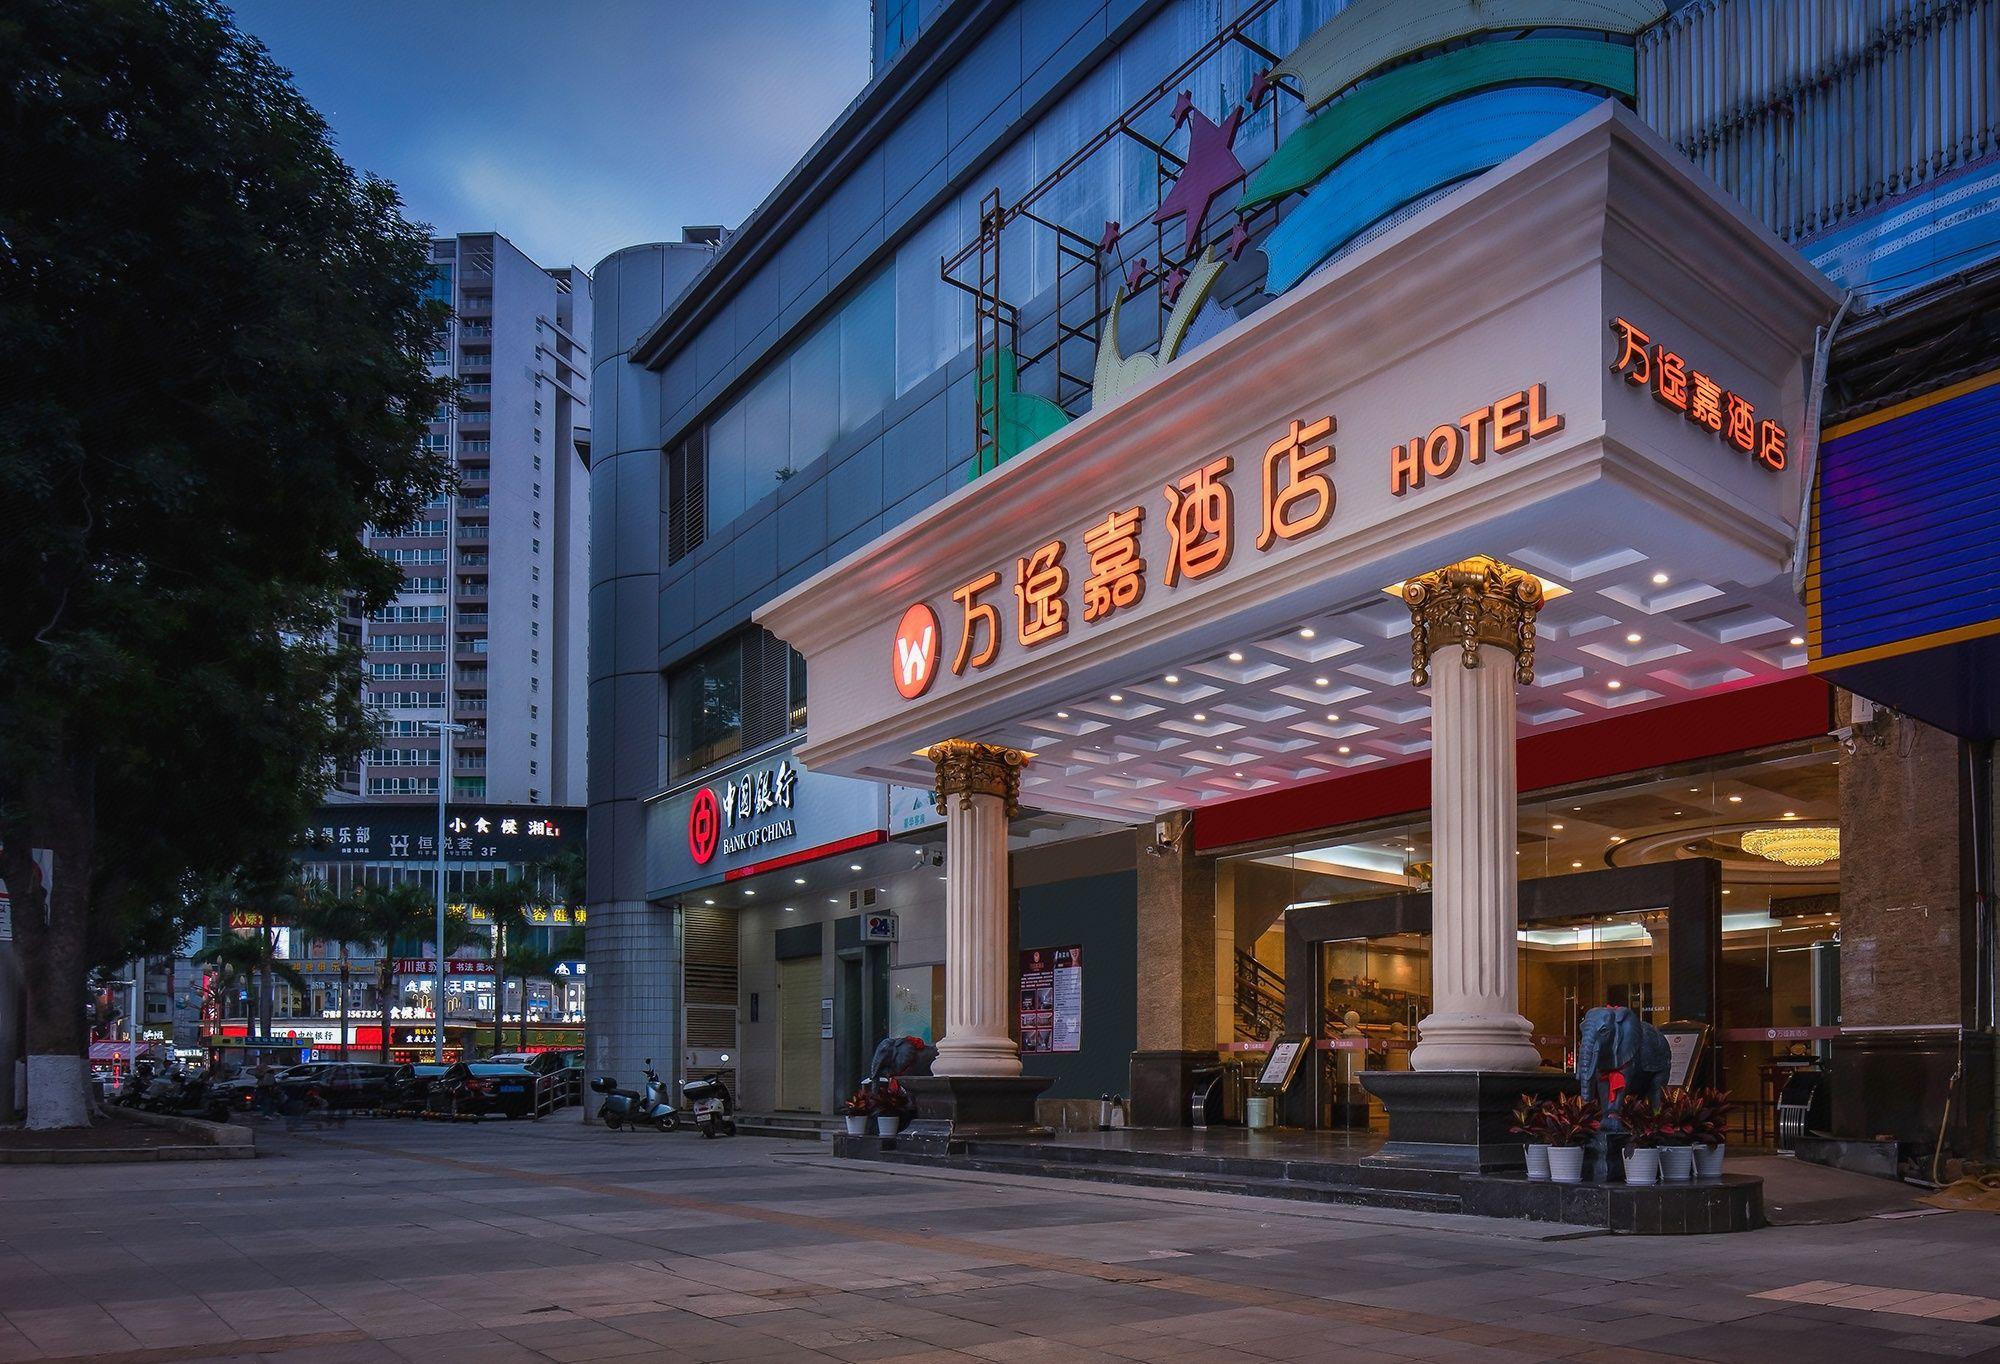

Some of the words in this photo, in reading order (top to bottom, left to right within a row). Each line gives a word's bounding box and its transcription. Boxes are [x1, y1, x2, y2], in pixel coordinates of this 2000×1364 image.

[1391, 383, 1563, 497] HOTEL
[1610, 317, 1788, 472] 万逸嘉酒店
[951, 415, 1338, 676] 万逸嘉酒店
[480, 847, 497, 857] 3F
[723, 832, 747, 855] BANK
[747, 829, 760, 847] OF
[761, 819, 794, 843] CHINA
